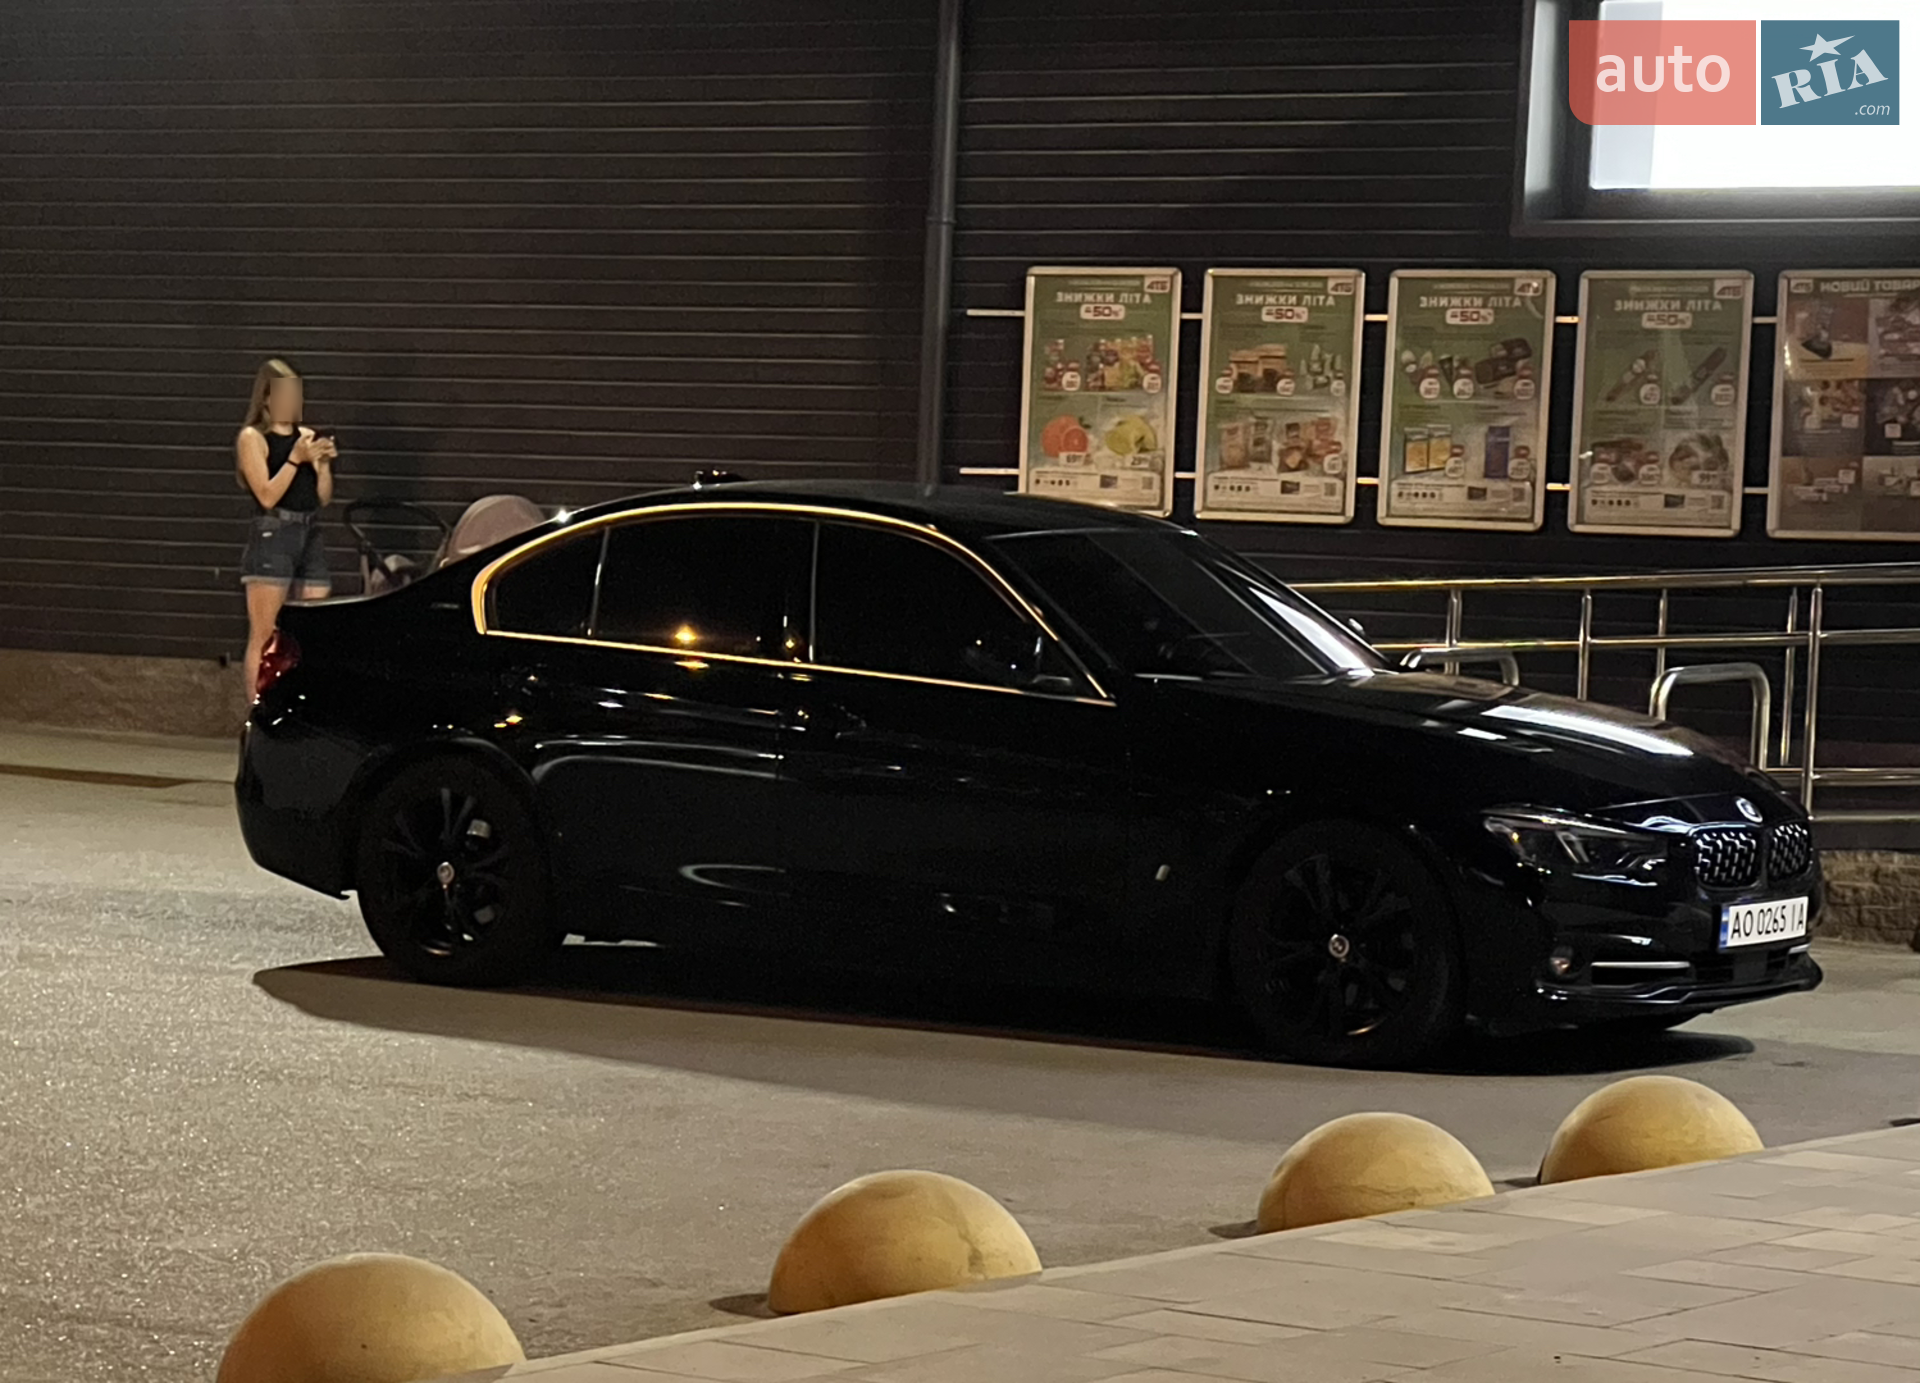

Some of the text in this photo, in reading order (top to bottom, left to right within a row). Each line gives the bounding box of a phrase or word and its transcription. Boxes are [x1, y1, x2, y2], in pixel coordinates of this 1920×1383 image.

[1056, 292, 1153, 305] ЗНИЖКИ ЛІТА
[1235, 293, 1336, 307] ЗНИЖКИ ЛІТА
[1419, 296, 1523, 308] ЗНИЖКИ ЛІТА
[1614, 299, 1723, 312] ЗНИЖКИ ЛІТА
[1731, 910, 1754, 939] AO
[1756, 905, 1787, 935] 0265
